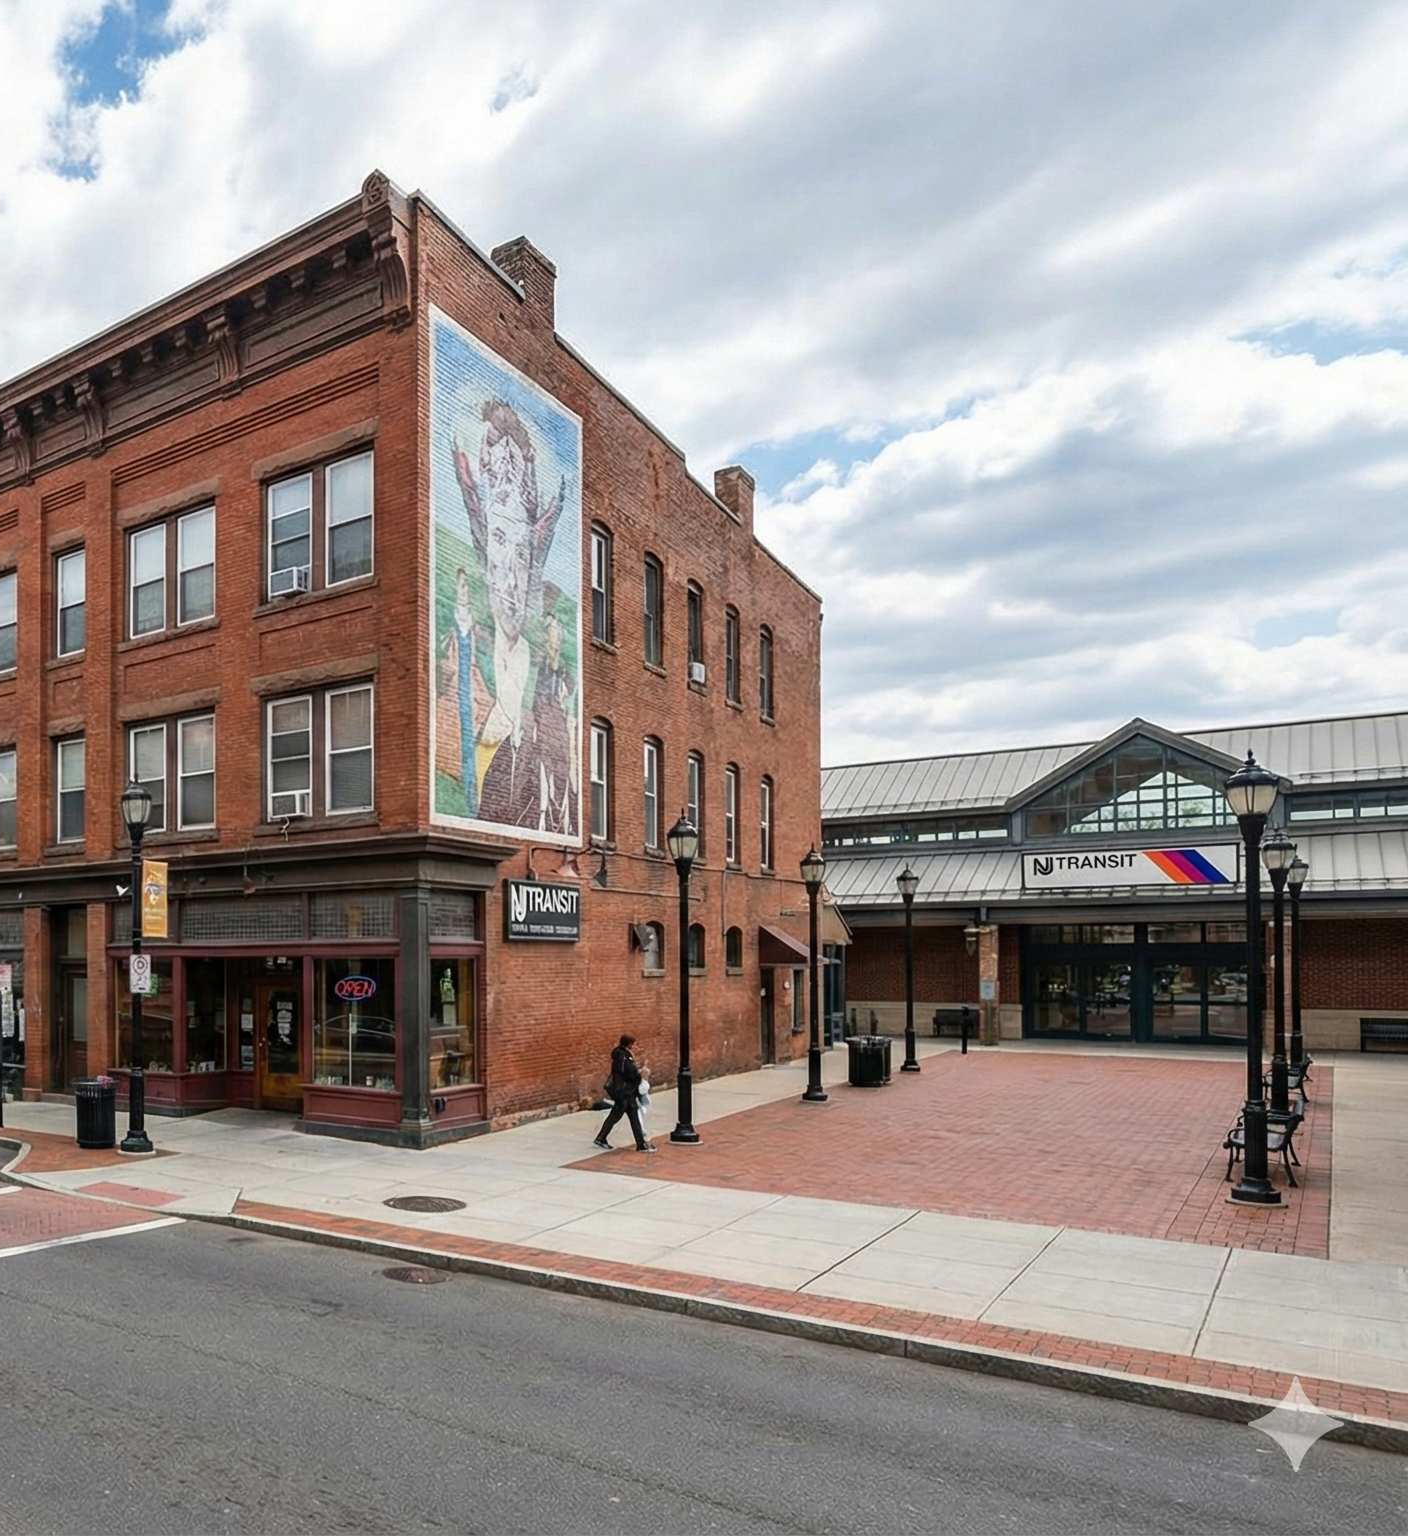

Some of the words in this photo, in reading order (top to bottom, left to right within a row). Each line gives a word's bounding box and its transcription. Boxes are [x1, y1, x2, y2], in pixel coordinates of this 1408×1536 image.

[1033, 856, 1053, 876] NJ
[1055, 853, 1137, 870] TRANSIT
[511, 883, 527, 922] NJ
[527, 886, 579, 914] TRANSIT
[335, 979, 372, 998] OPEN
